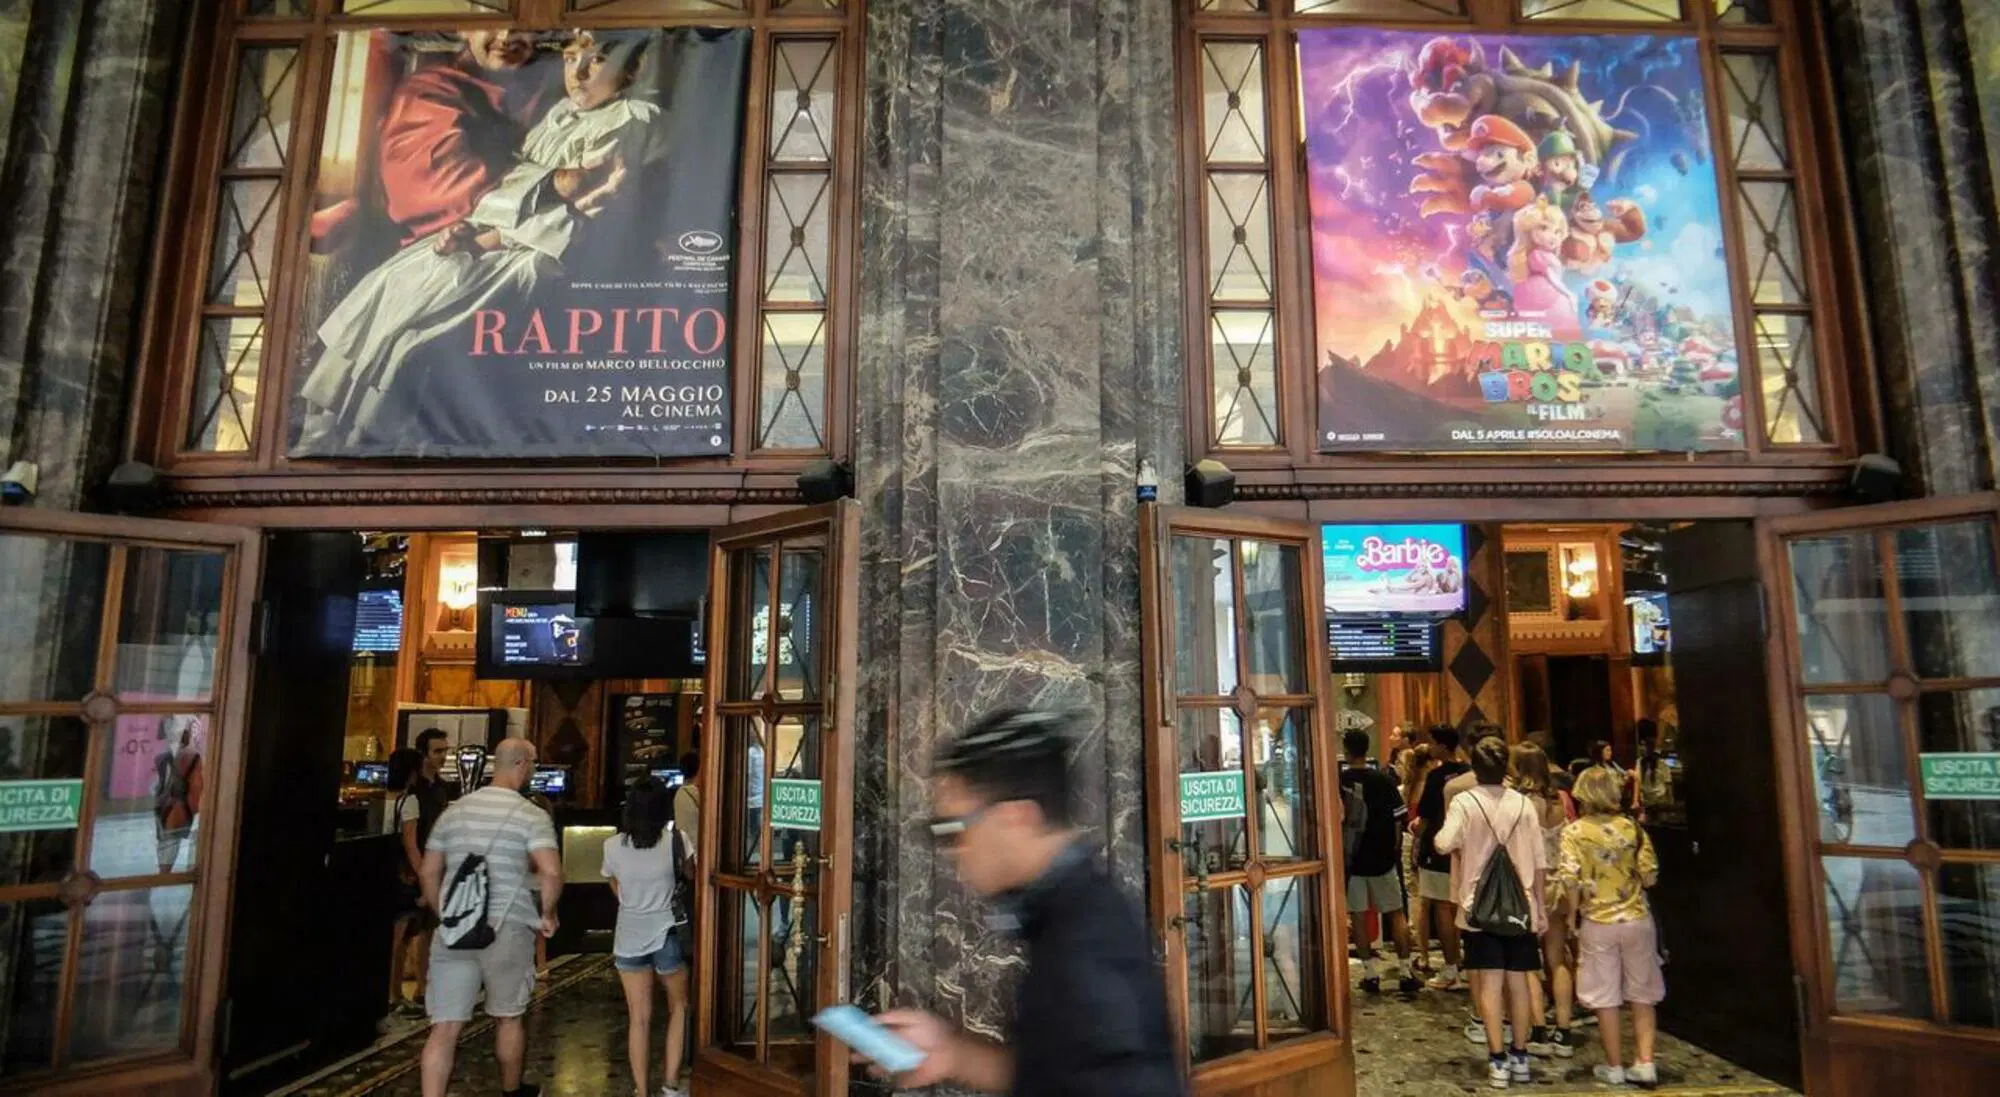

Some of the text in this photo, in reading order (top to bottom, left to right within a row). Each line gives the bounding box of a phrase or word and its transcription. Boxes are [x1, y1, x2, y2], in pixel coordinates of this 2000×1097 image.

[467, 307, 727, 356] RAPITO
[1485, 321, 1553, 339] SUPER
[546, 361, 571, 370] FILM
[572, 362, 584, 370] DI
[586, 359, 636, 370] MARCO
[639, 358, 726, 370] BELLOCCHIO
[1466, 340, 1595, 373] MARIO
[544, 384, 724, 404] DAL 25 MAGGIO
[621, 403, 723, 418] AL CINEMA
[1538, 404, 1586, 421] FILM
[1451, 429, 1621, 441] DAL 5 APRILE #SOLOALCINEMA
[1357, 537, 1450, 571] Barbie
[505, 607, 528, 618] MENU
[1930, 760, 1994, 776] USCITA
[1183, 777, 1237, 796] USCITA DI
[1927, 776, 2000, 793] SICUREZ
[0, 786, 72, 805] CITA DI
[776, 786, 818, 804] USCITA DI
[772, 804, 820, 822] SICUREZZA
[1181, 794, 1244, 815] SICUREZZA
[0, 804, 75, 824] UREZZA
